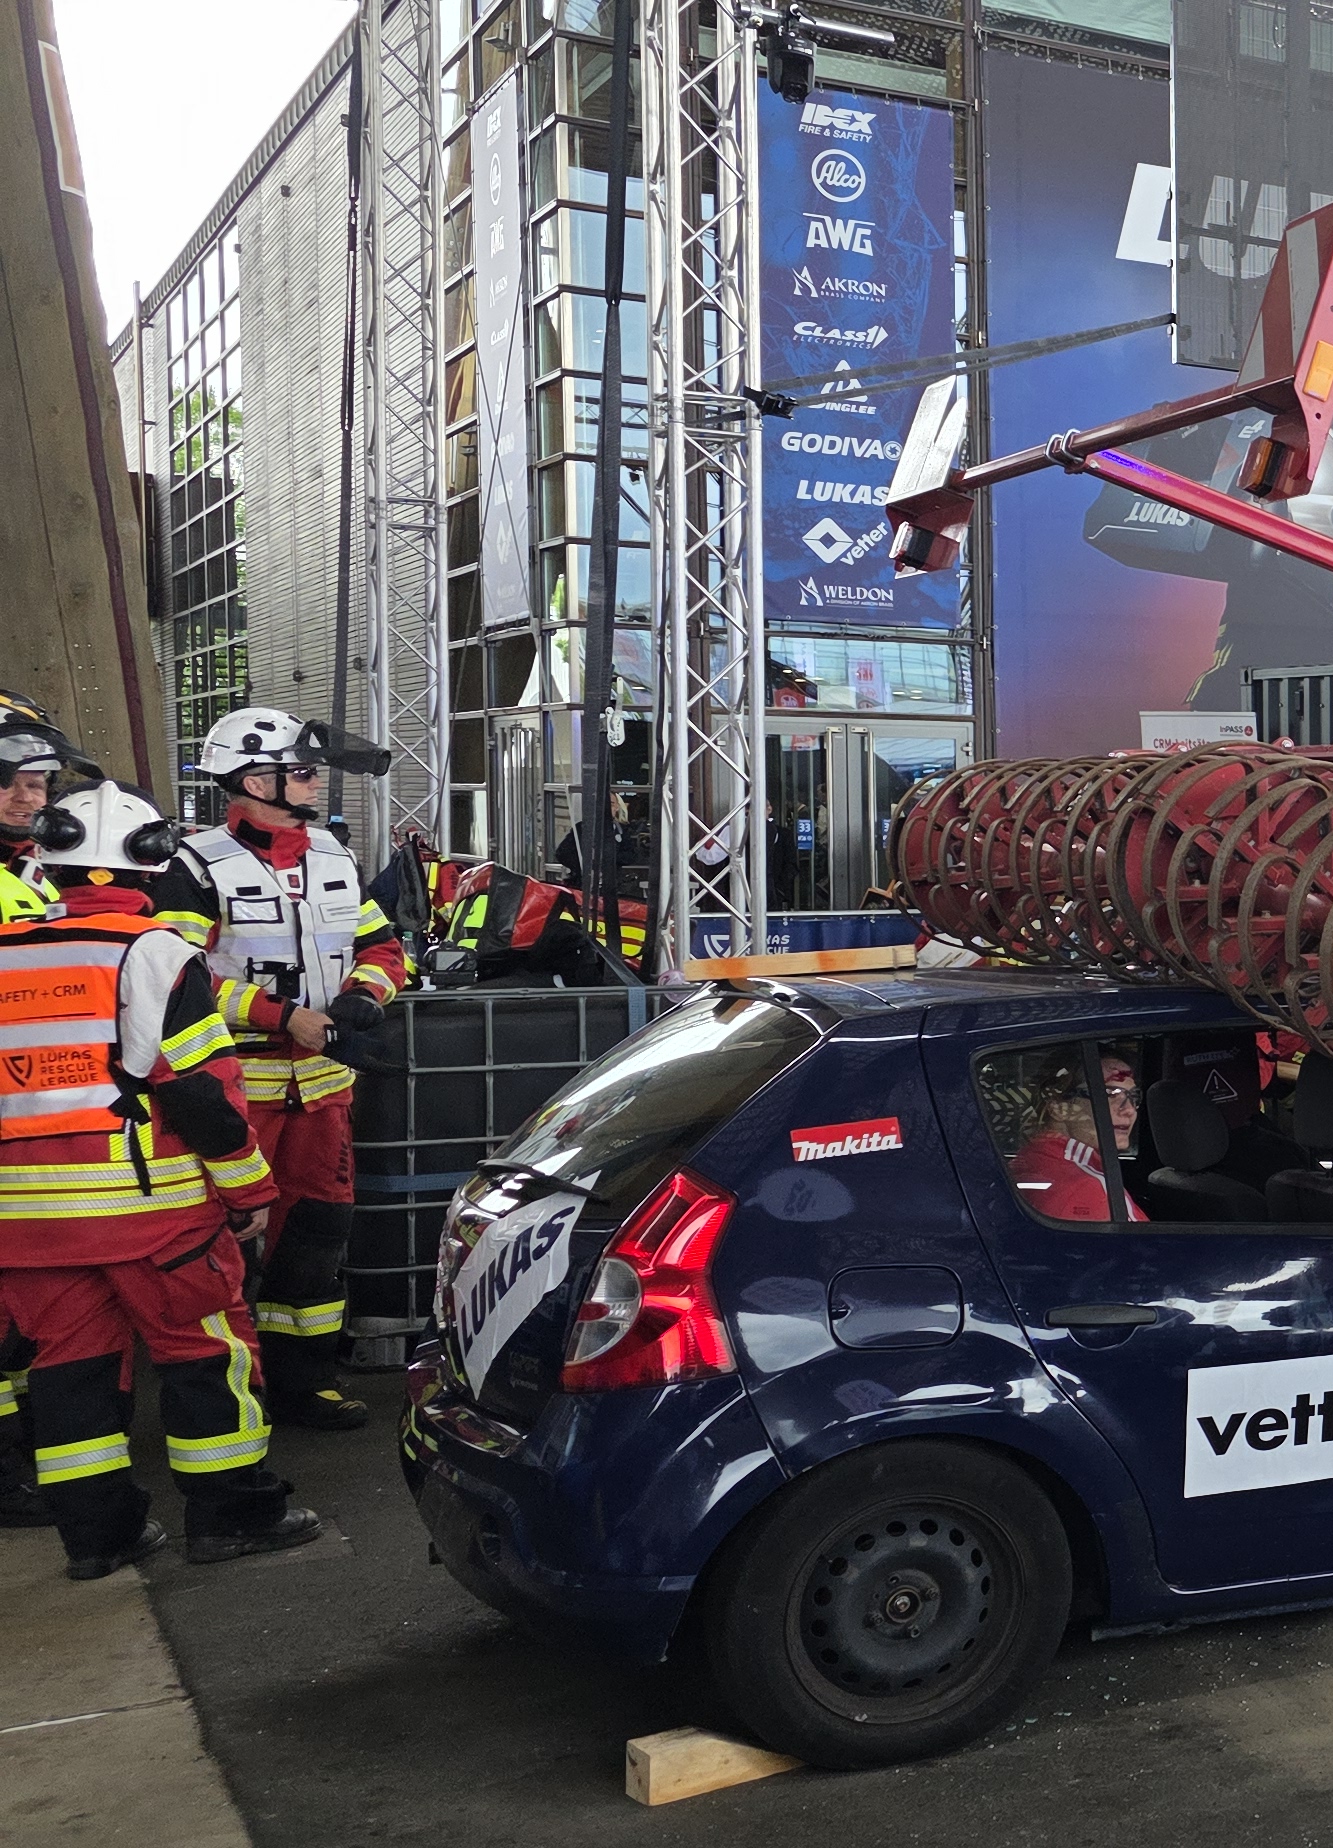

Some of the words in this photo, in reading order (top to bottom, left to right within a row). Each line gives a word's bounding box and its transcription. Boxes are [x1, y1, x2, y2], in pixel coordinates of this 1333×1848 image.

[801, 102, 877, 134] IDEX
[799, 124, 821, 136] FIRE
[824, 127, 832, 137] &
[832, 129, 873, 144] SAFETY
[816, 160, 862, 189] Alco
[802, 212, 876, 257] AWG
[821, 276, 886, 297] AKRON
[847, 293, 886, 303] COMPANY
[793, 335, 873, 349] ELECTRONICS
[781, 431, 886, 460] GODIVA
[796, 479, 891, 507] LUKAS
[840, 521, 889, 566] vetter
[823, 585, 894, 601] WELDON
[52, 983, 87, 998] CRM
[39, 1050, 92, 1064] LUKAS
[40, 1061, 97, 1075] RESCUE
[40, 1072, 99, 1088] LEAGUE
[791, 1131, 904, 1162] makita
[460, 1205, 576, 1359] LUKAS
